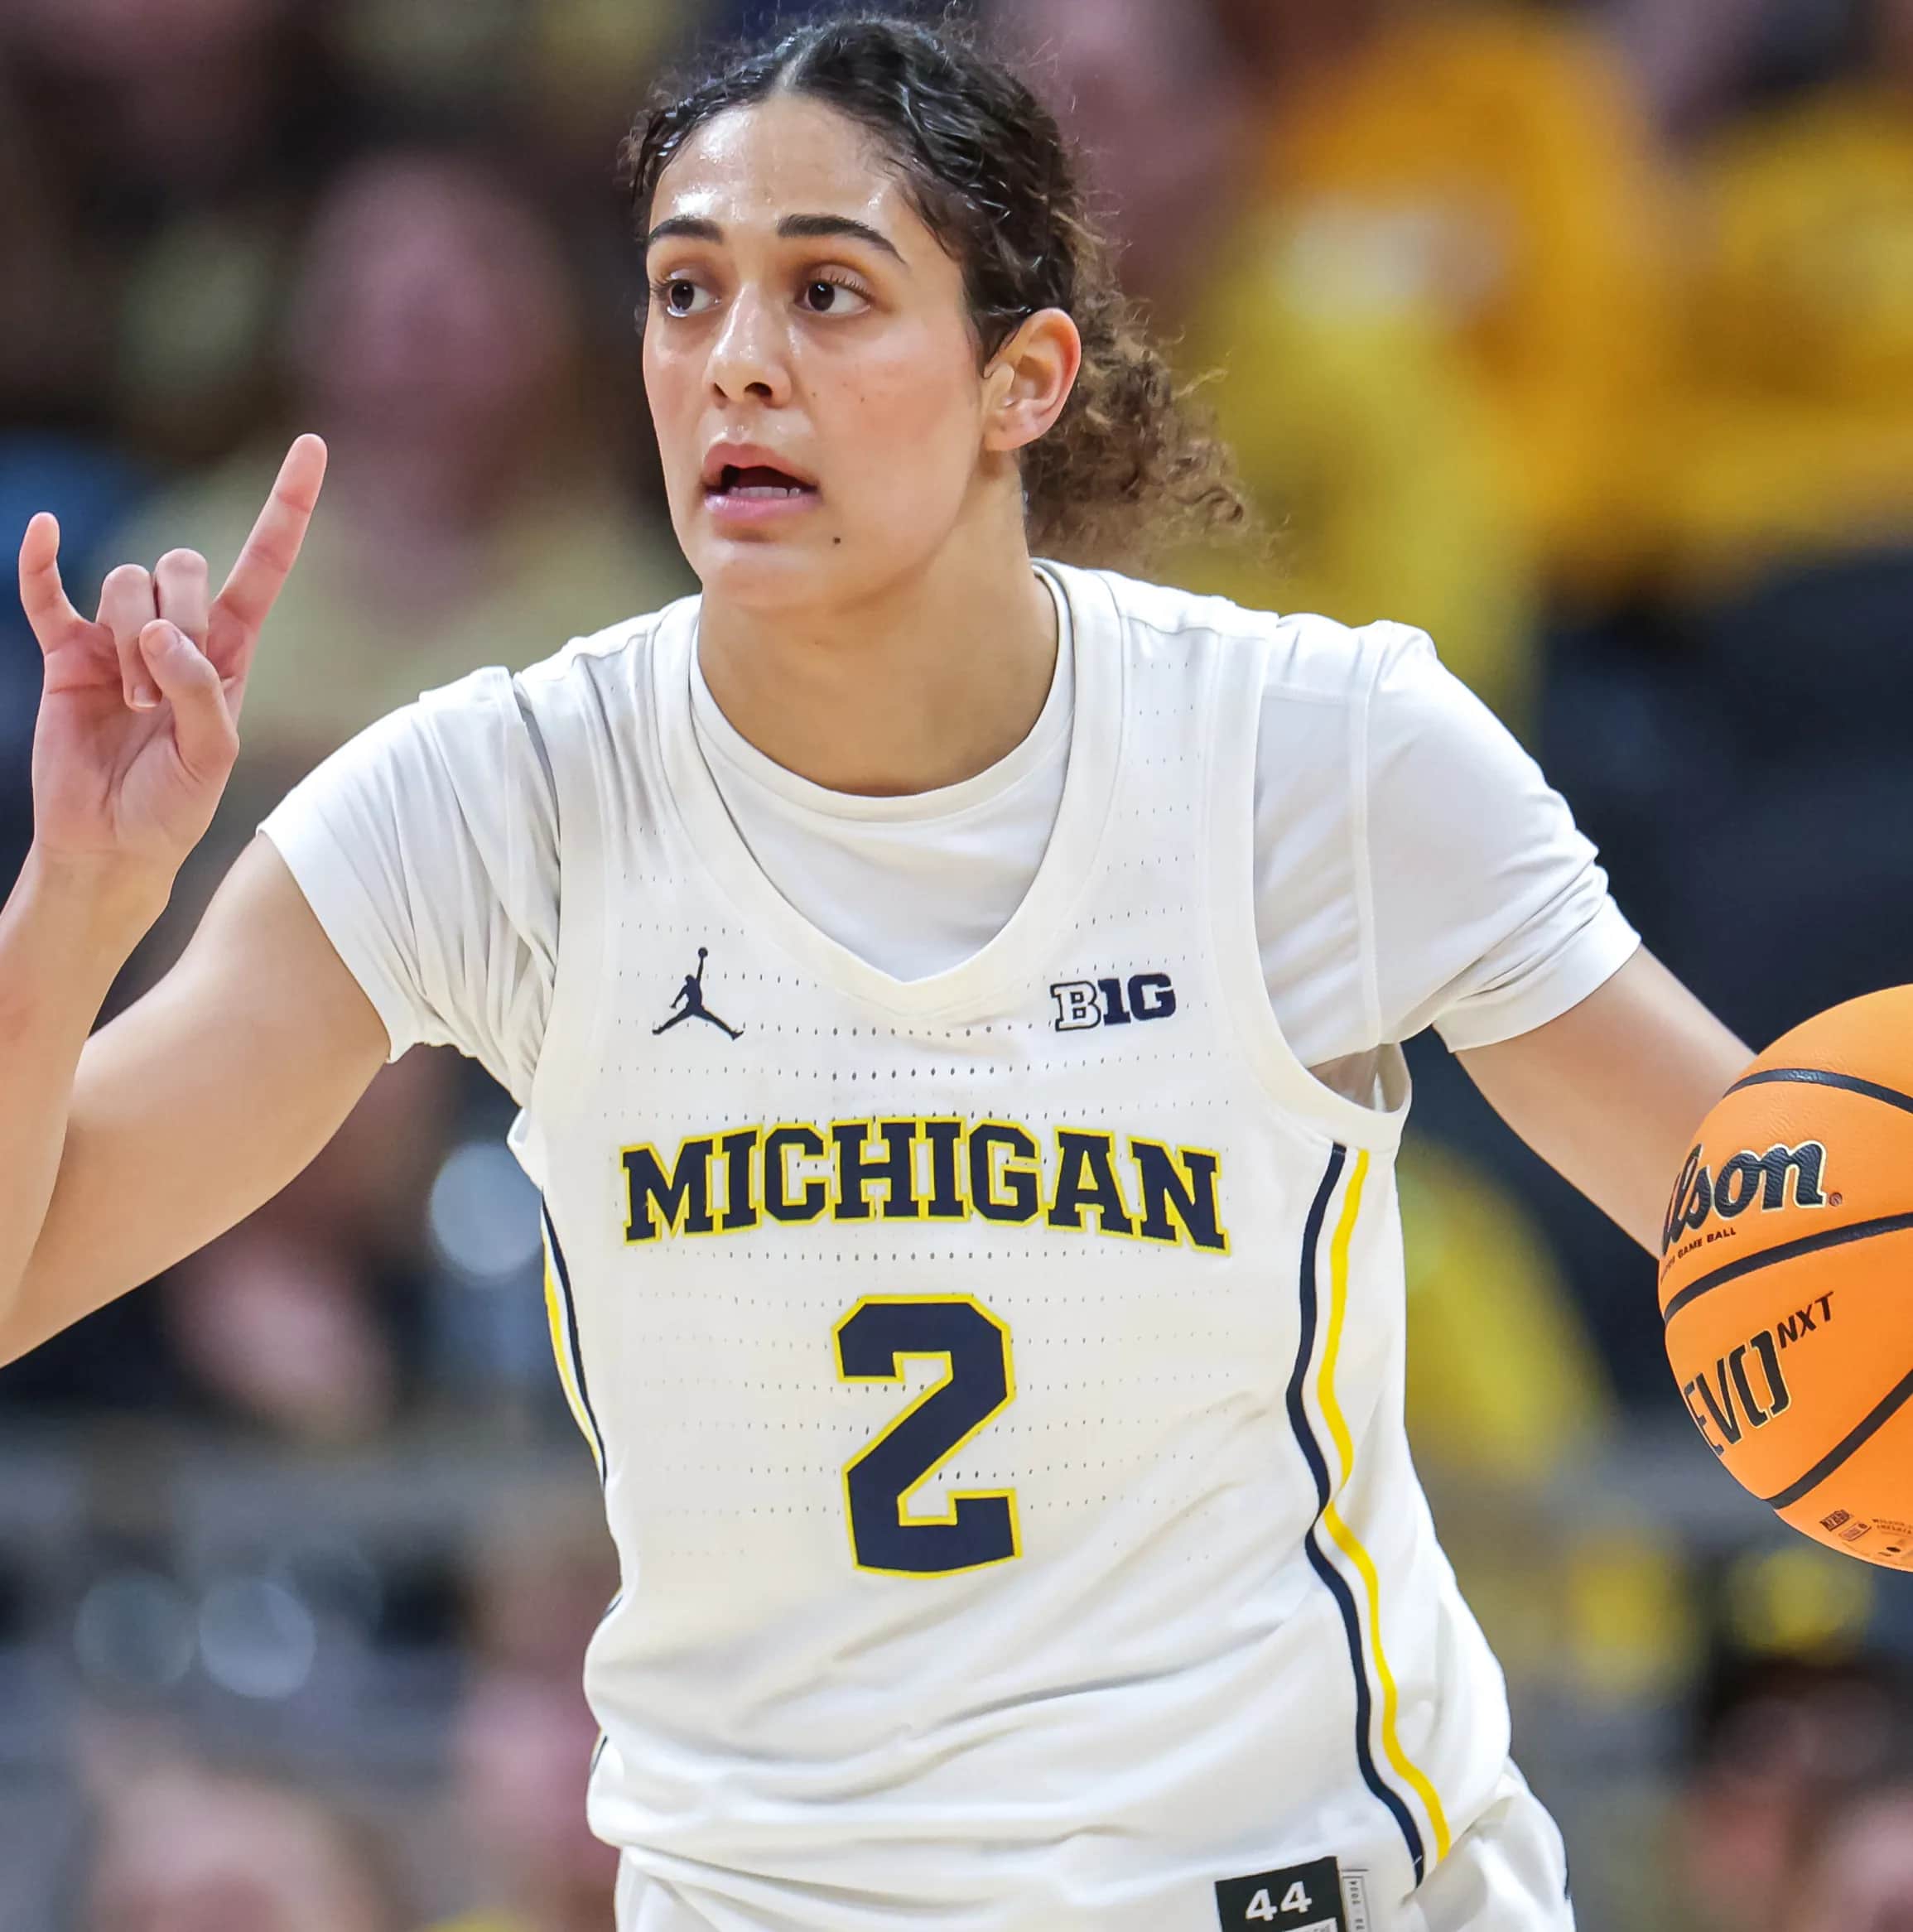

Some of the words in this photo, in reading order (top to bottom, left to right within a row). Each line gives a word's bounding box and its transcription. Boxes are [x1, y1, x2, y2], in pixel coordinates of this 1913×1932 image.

[619, 1115, 1231, 1256] MICHIGAN
[1677, 1236, 1703, 1259] GAME
[1706, 1226, 1737, 1244] BALL
[1776, 1290, 1834, 1349] NXT
[831, 1293, 1024, 1580] 2
[1245, 1880, 1313, 1922] 44
